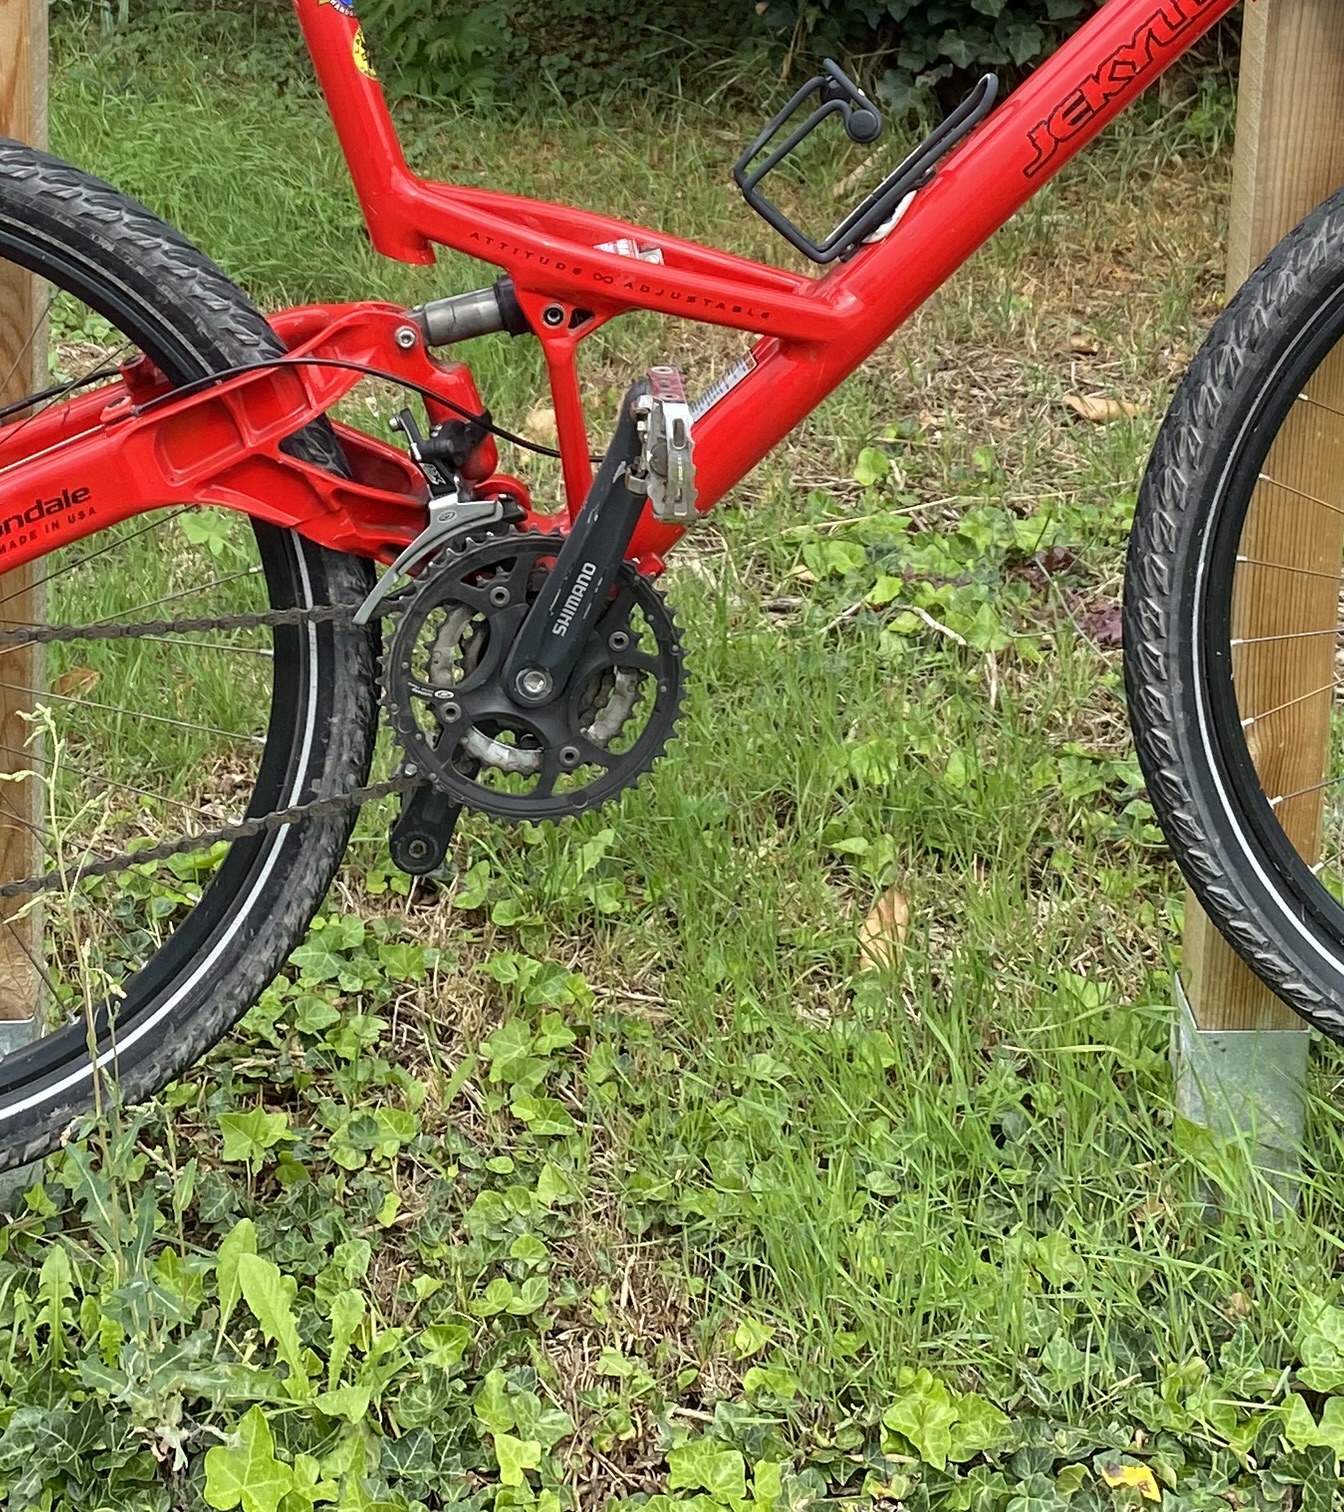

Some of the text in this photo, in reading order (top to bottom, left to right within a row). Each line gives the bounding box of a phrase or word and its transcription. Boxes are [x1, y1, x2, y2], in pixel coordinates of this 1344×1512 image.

[469, 231, 771, 319] ATTITUDE ADJUSTABLE
[44, 519, 61, 534] IN
[67, 506, 98, 525] USA
[551, 561, 597, 638] SHIMANO
